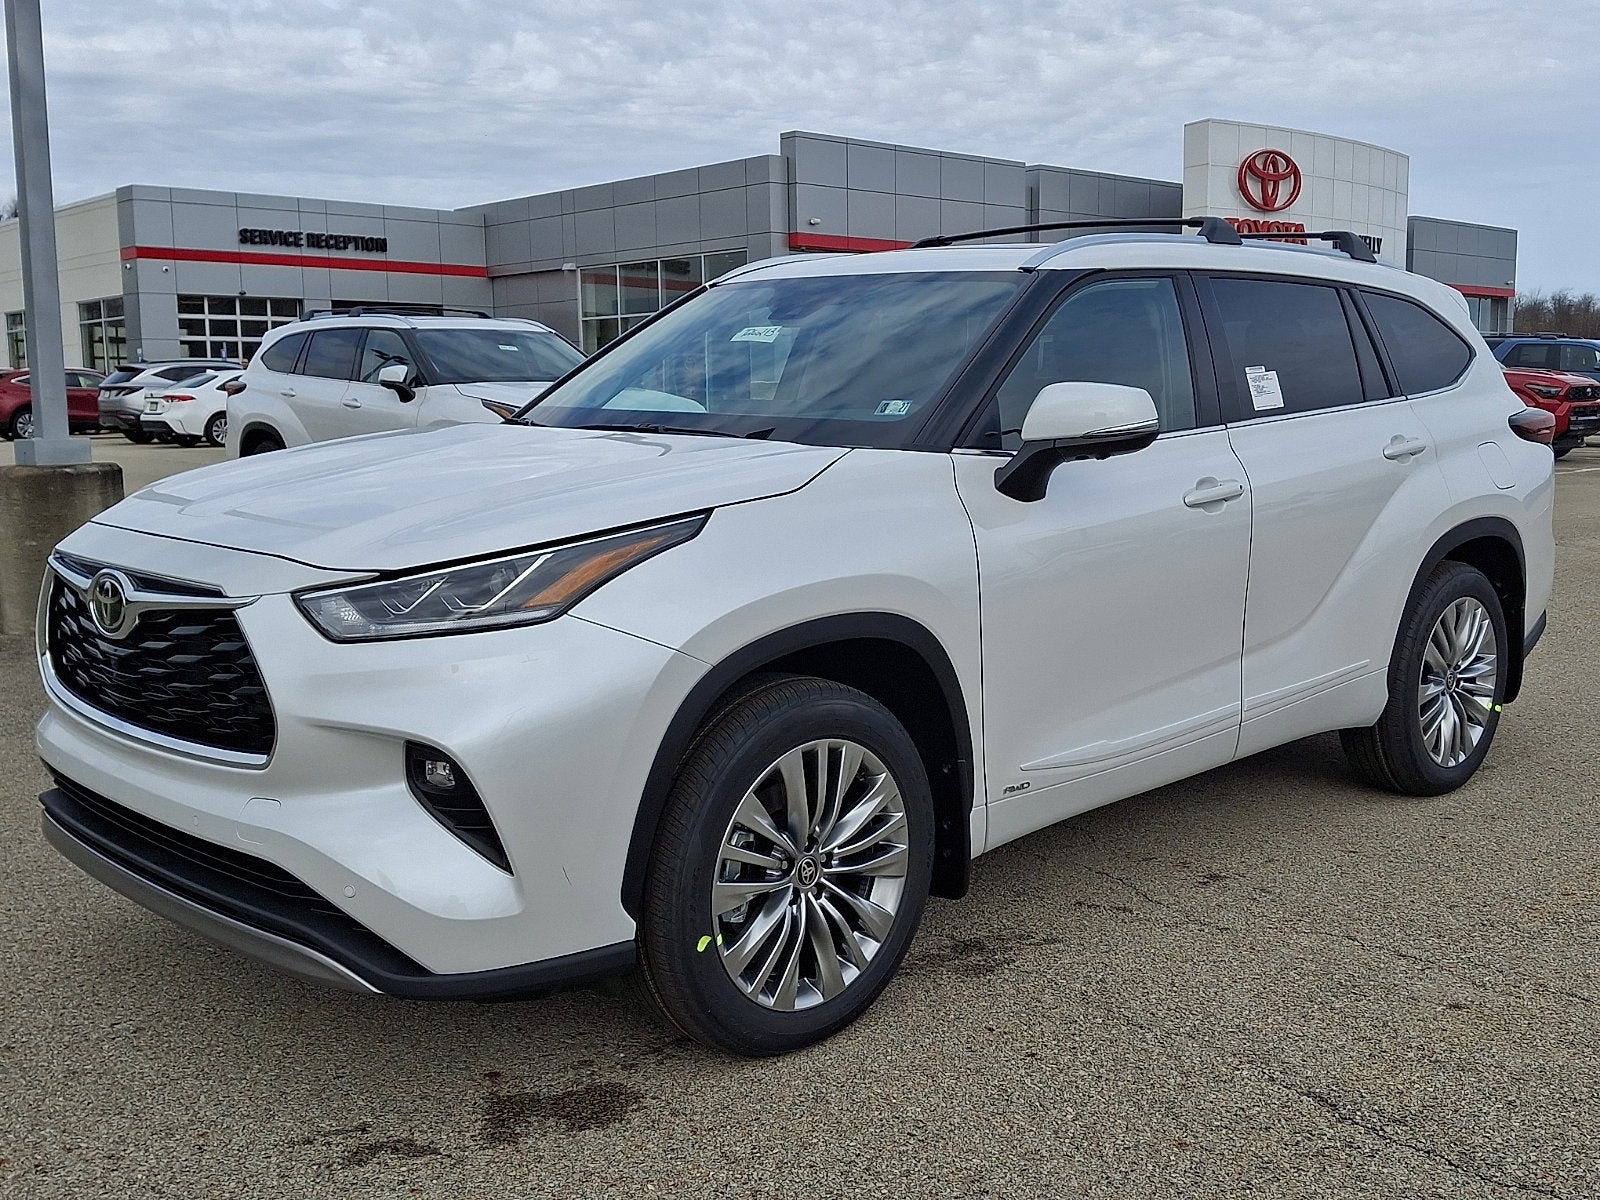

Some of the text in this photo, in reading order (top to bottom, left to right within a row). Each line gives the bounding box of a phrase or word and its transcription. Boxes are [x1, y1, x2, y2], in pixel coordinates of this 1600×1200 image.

[239, 227, 388, 253] SERVICE RECEPTION
[1003, 781, 1031, 795] AWD
